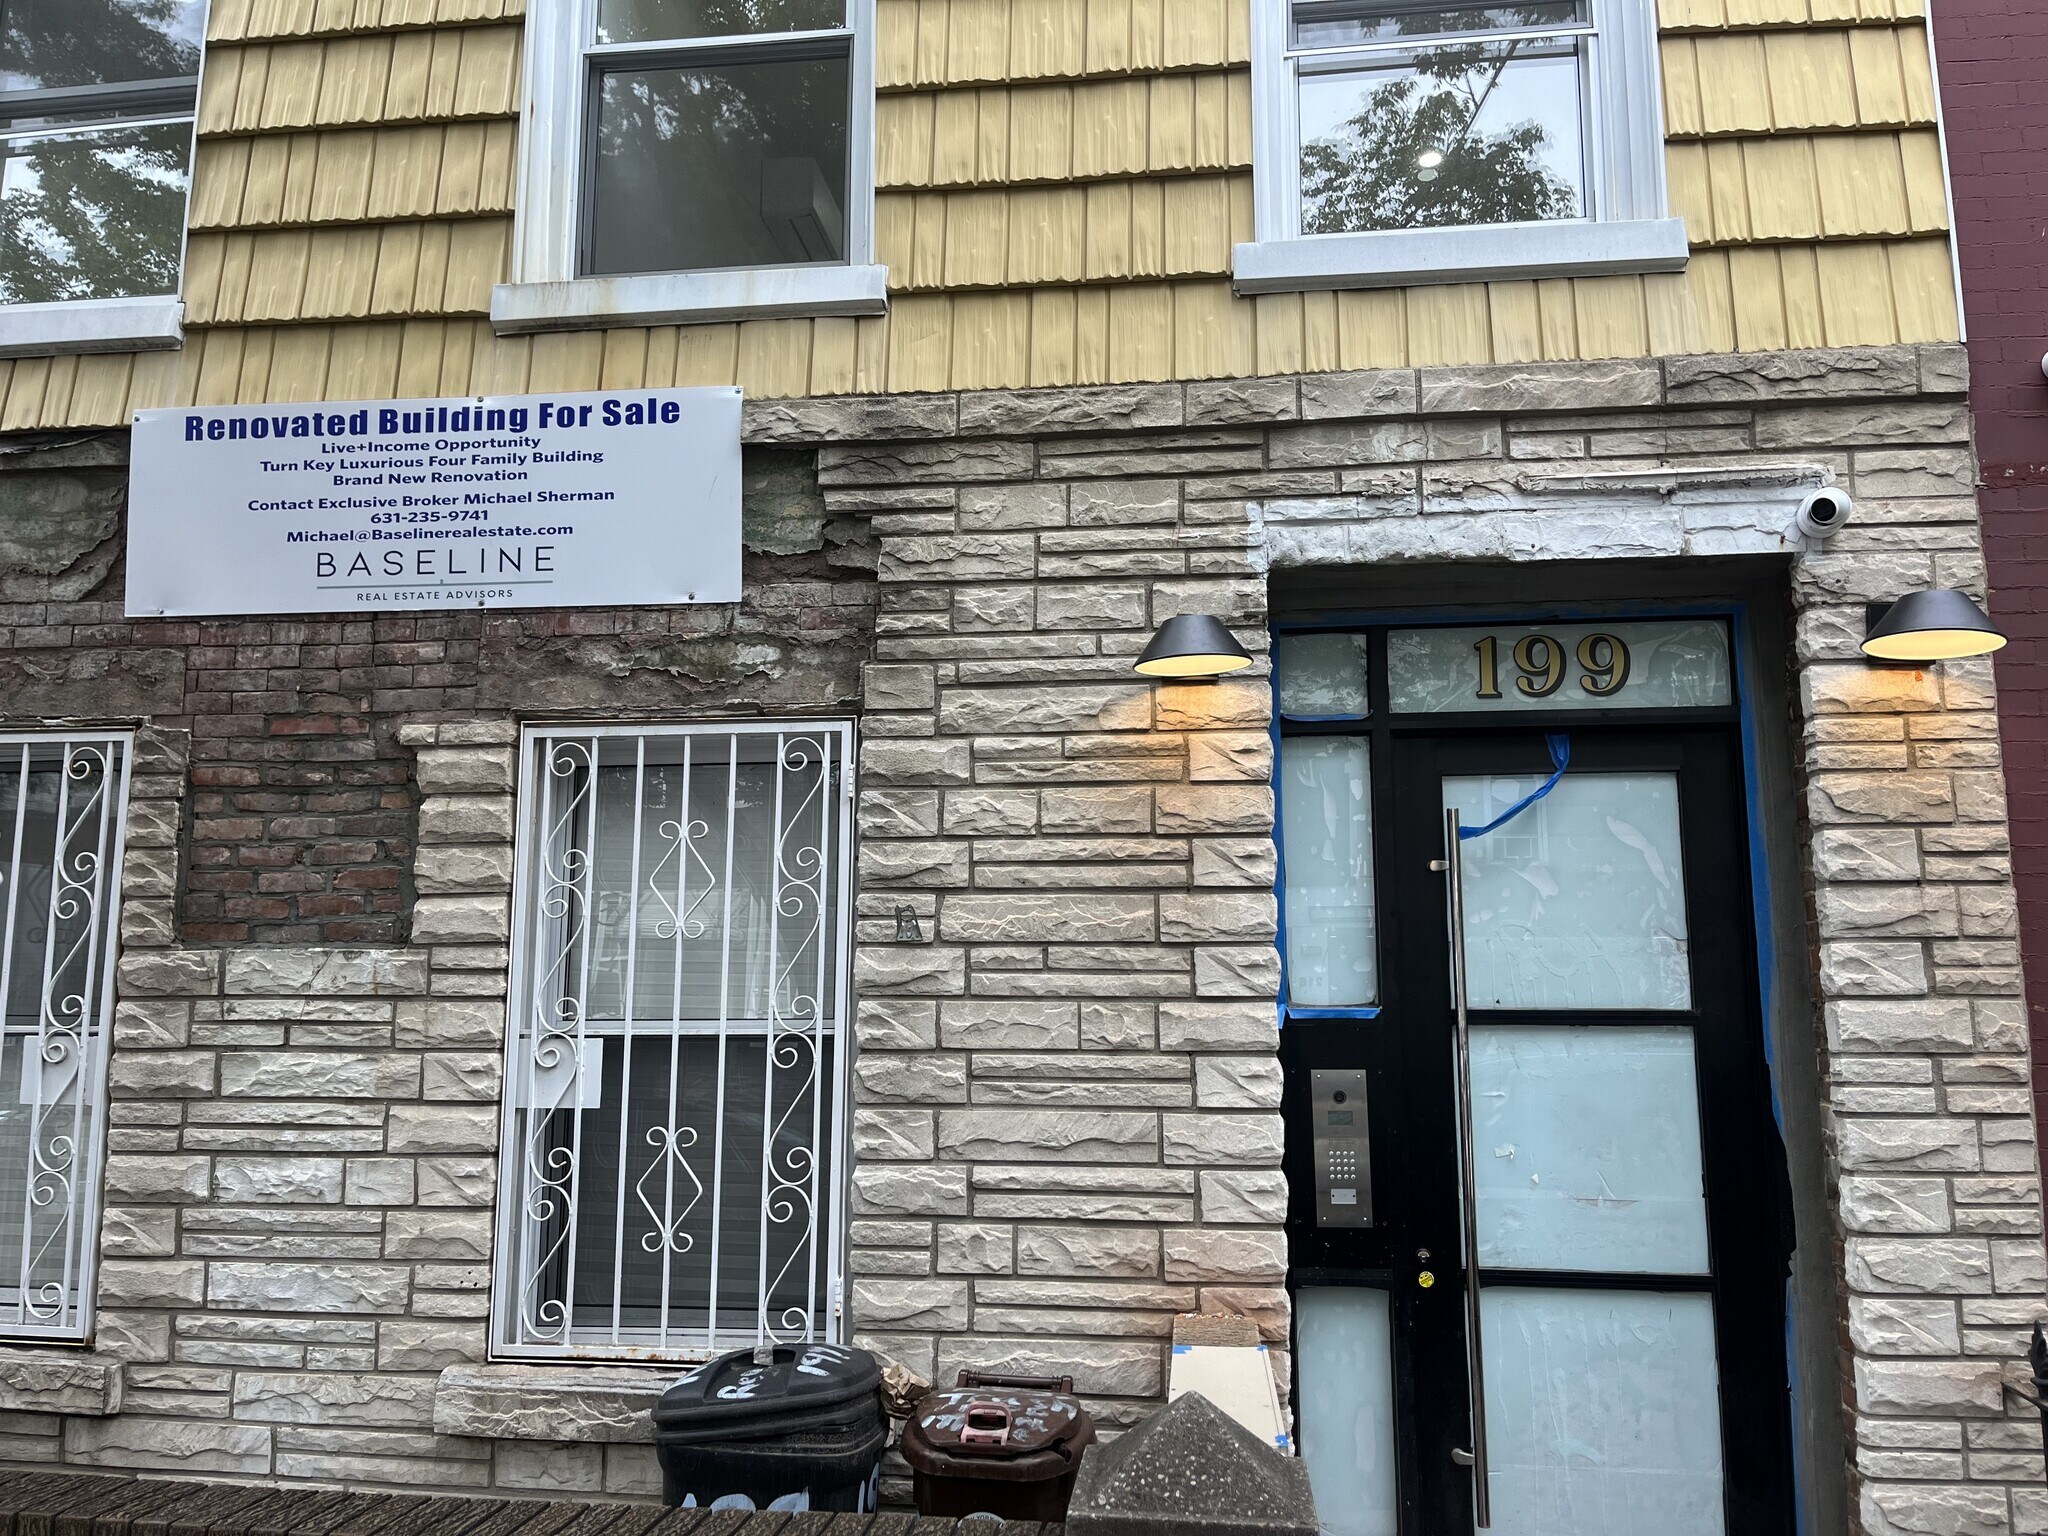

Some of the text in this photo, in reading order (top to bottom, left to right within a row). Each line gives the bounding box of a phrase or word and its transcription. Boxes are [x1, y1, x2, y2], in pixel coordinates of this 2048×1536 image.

[184, 397, 680, 442] Renovated Building For Sale
[321, 435, 542, 454] Live+Income Opportunity
[259, 449, 604, 473] Turn Key Luxurious Four Family Building
[333, 469, 528, 486] Brand New Renovation
[247, 490, 615, 512] Contact Exclusive Broker Michael Sherman
[370, 509, 488, 524] 631-235-9741
[286, 525, 574, 543] Michael@Baselinerealestate.com
[316, 545, 555, 578] BASELINE
[356, 589, 513, 602] REAL ESTATE ADVISORS
[1473, 632, 1631, 699] 199
